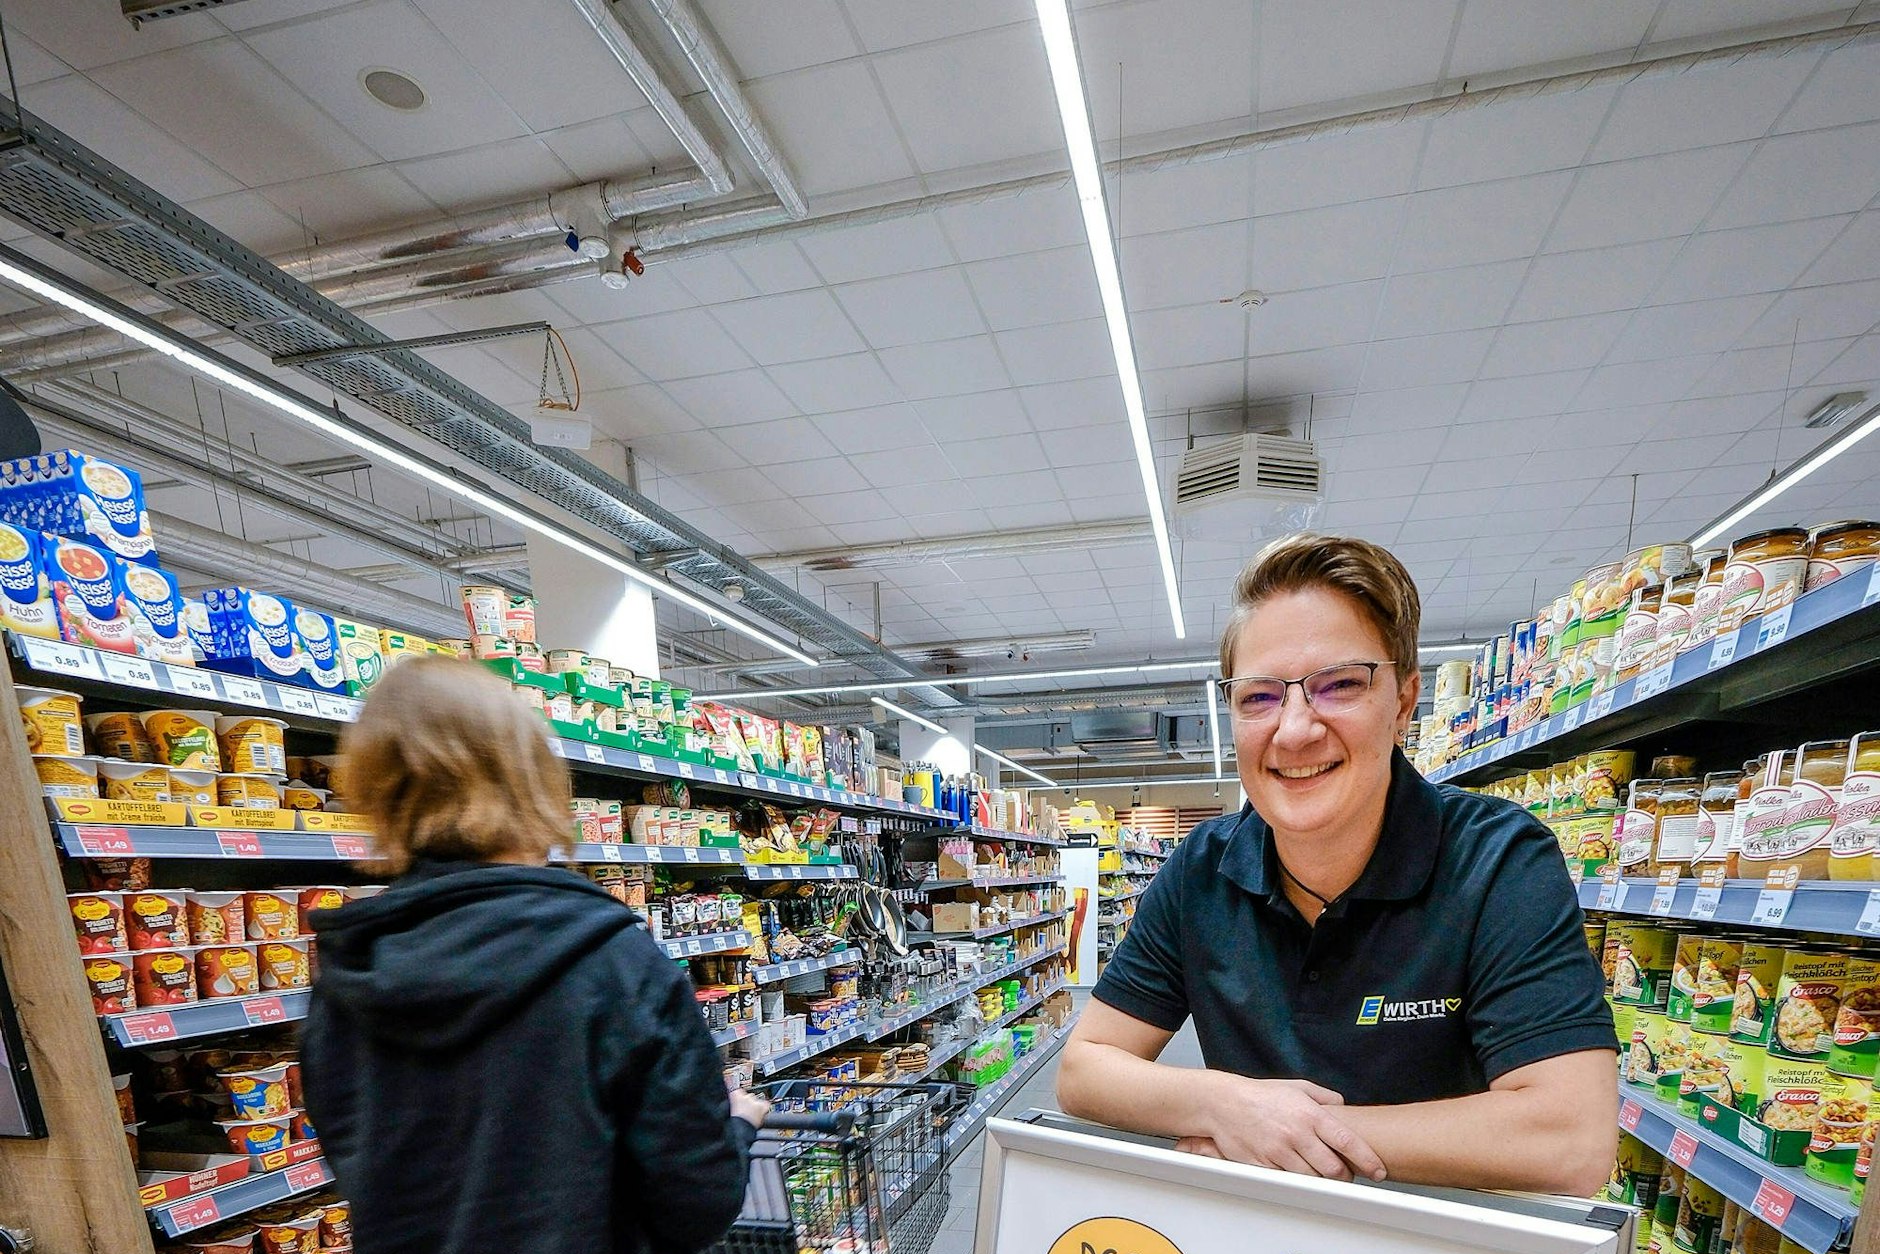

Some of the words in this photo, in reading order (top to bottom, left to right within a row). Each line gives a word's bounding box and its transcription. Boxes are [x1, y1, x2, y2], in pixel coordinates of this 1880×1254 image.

[93, 493, 136, 511] Heisse
[103, 508, 138, 524] Tasse
[0, 560, 34, 577] eisse
[67, 576, 113, 595] Heisse
[82, 592, 114, 607] Tasse
[9, 603, 43, 617] Huhn
[137, 598, 174, 614] Heisse
[86, 617, 127, 634] Tomaten
[149, 612, 175, 627] Tasse
[259, 623, 290, 638] Heisse
[267, 635, 291, 648] Tasse
[304, 637, 332, 652] Heisse
[312, 648, 333, 660] Tasse
[55, 655, 80, 668] 0.89
[128, 669, 150, 681] 0.89
[192, 681, 211, 692] 0.89
[243, 690, 261, 700] 0.89
[297, 700, 313, 710] 0.89
[332, 706, 348, 716] 0.89
[108, 803, 163, 812] KARTOFFELBREI
[107, 812, 118, 820] mit
[231, 810, 276, 819] KARTOFFELBREI
[105, 841, 127, 849] 1.49
[239, 844, 257, 852] 1.49
[1767, 907, 1783, 918] 6.99
[1793, 962, 1828, 973] Reistopf
[1828, 961, 1845, 969] mit
[1792, 983, 1837, 997] Erasco
[1384, 999, 1446, 1017] WIRTH
[148, 1025, 169, 1034] 1.49
[1778, 1069, 1812, 1079] Reistopf
[1776, 1089, 1820, 1101] Erasco
[303, 1173, 320, 1183] 1.49
[193, 1209, 213, 1220] 1.49
[1768, 1201, 1785, 1216] 3.29
